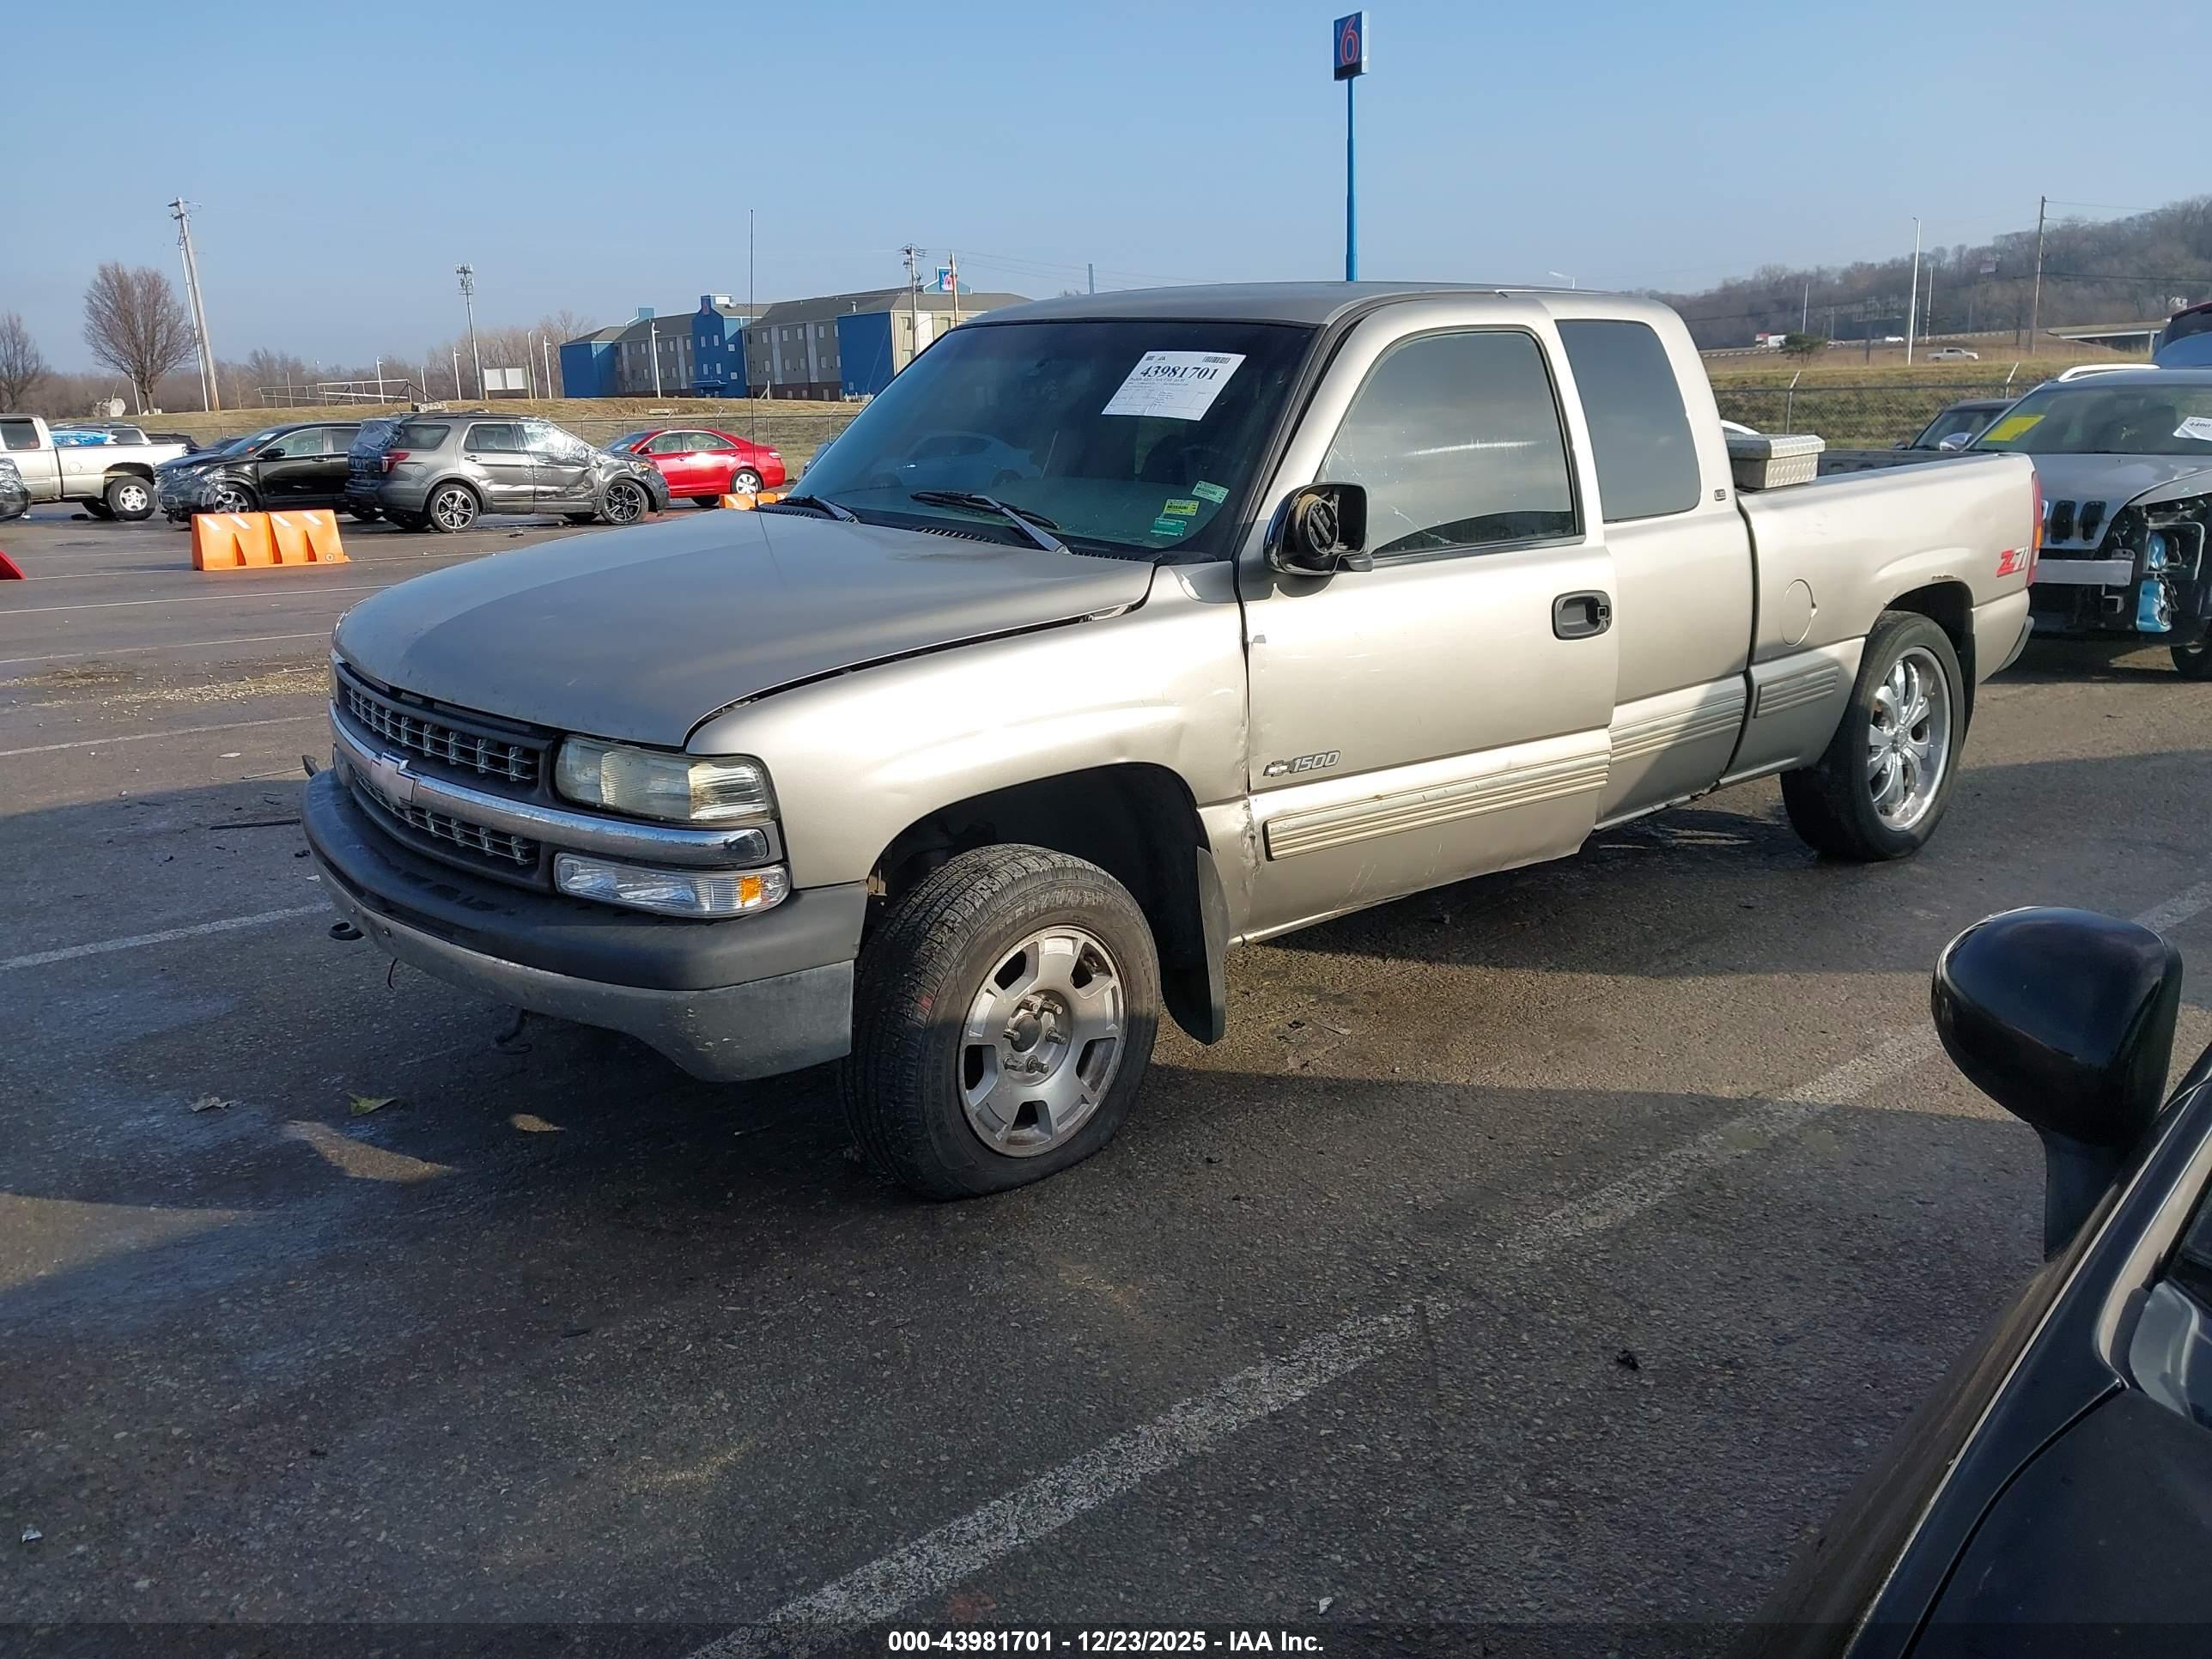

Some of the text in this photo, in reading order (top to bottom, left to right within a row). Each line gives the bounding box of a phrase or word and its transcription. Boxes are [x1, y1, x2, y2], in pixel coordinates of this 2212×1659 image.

[1340, 15, 1359, 65] 6
[1140, 365, 1219, 380] 43981701
[1996, 546, 2029, 577] Z71
[1292, 750, 1341, 774] 1500
